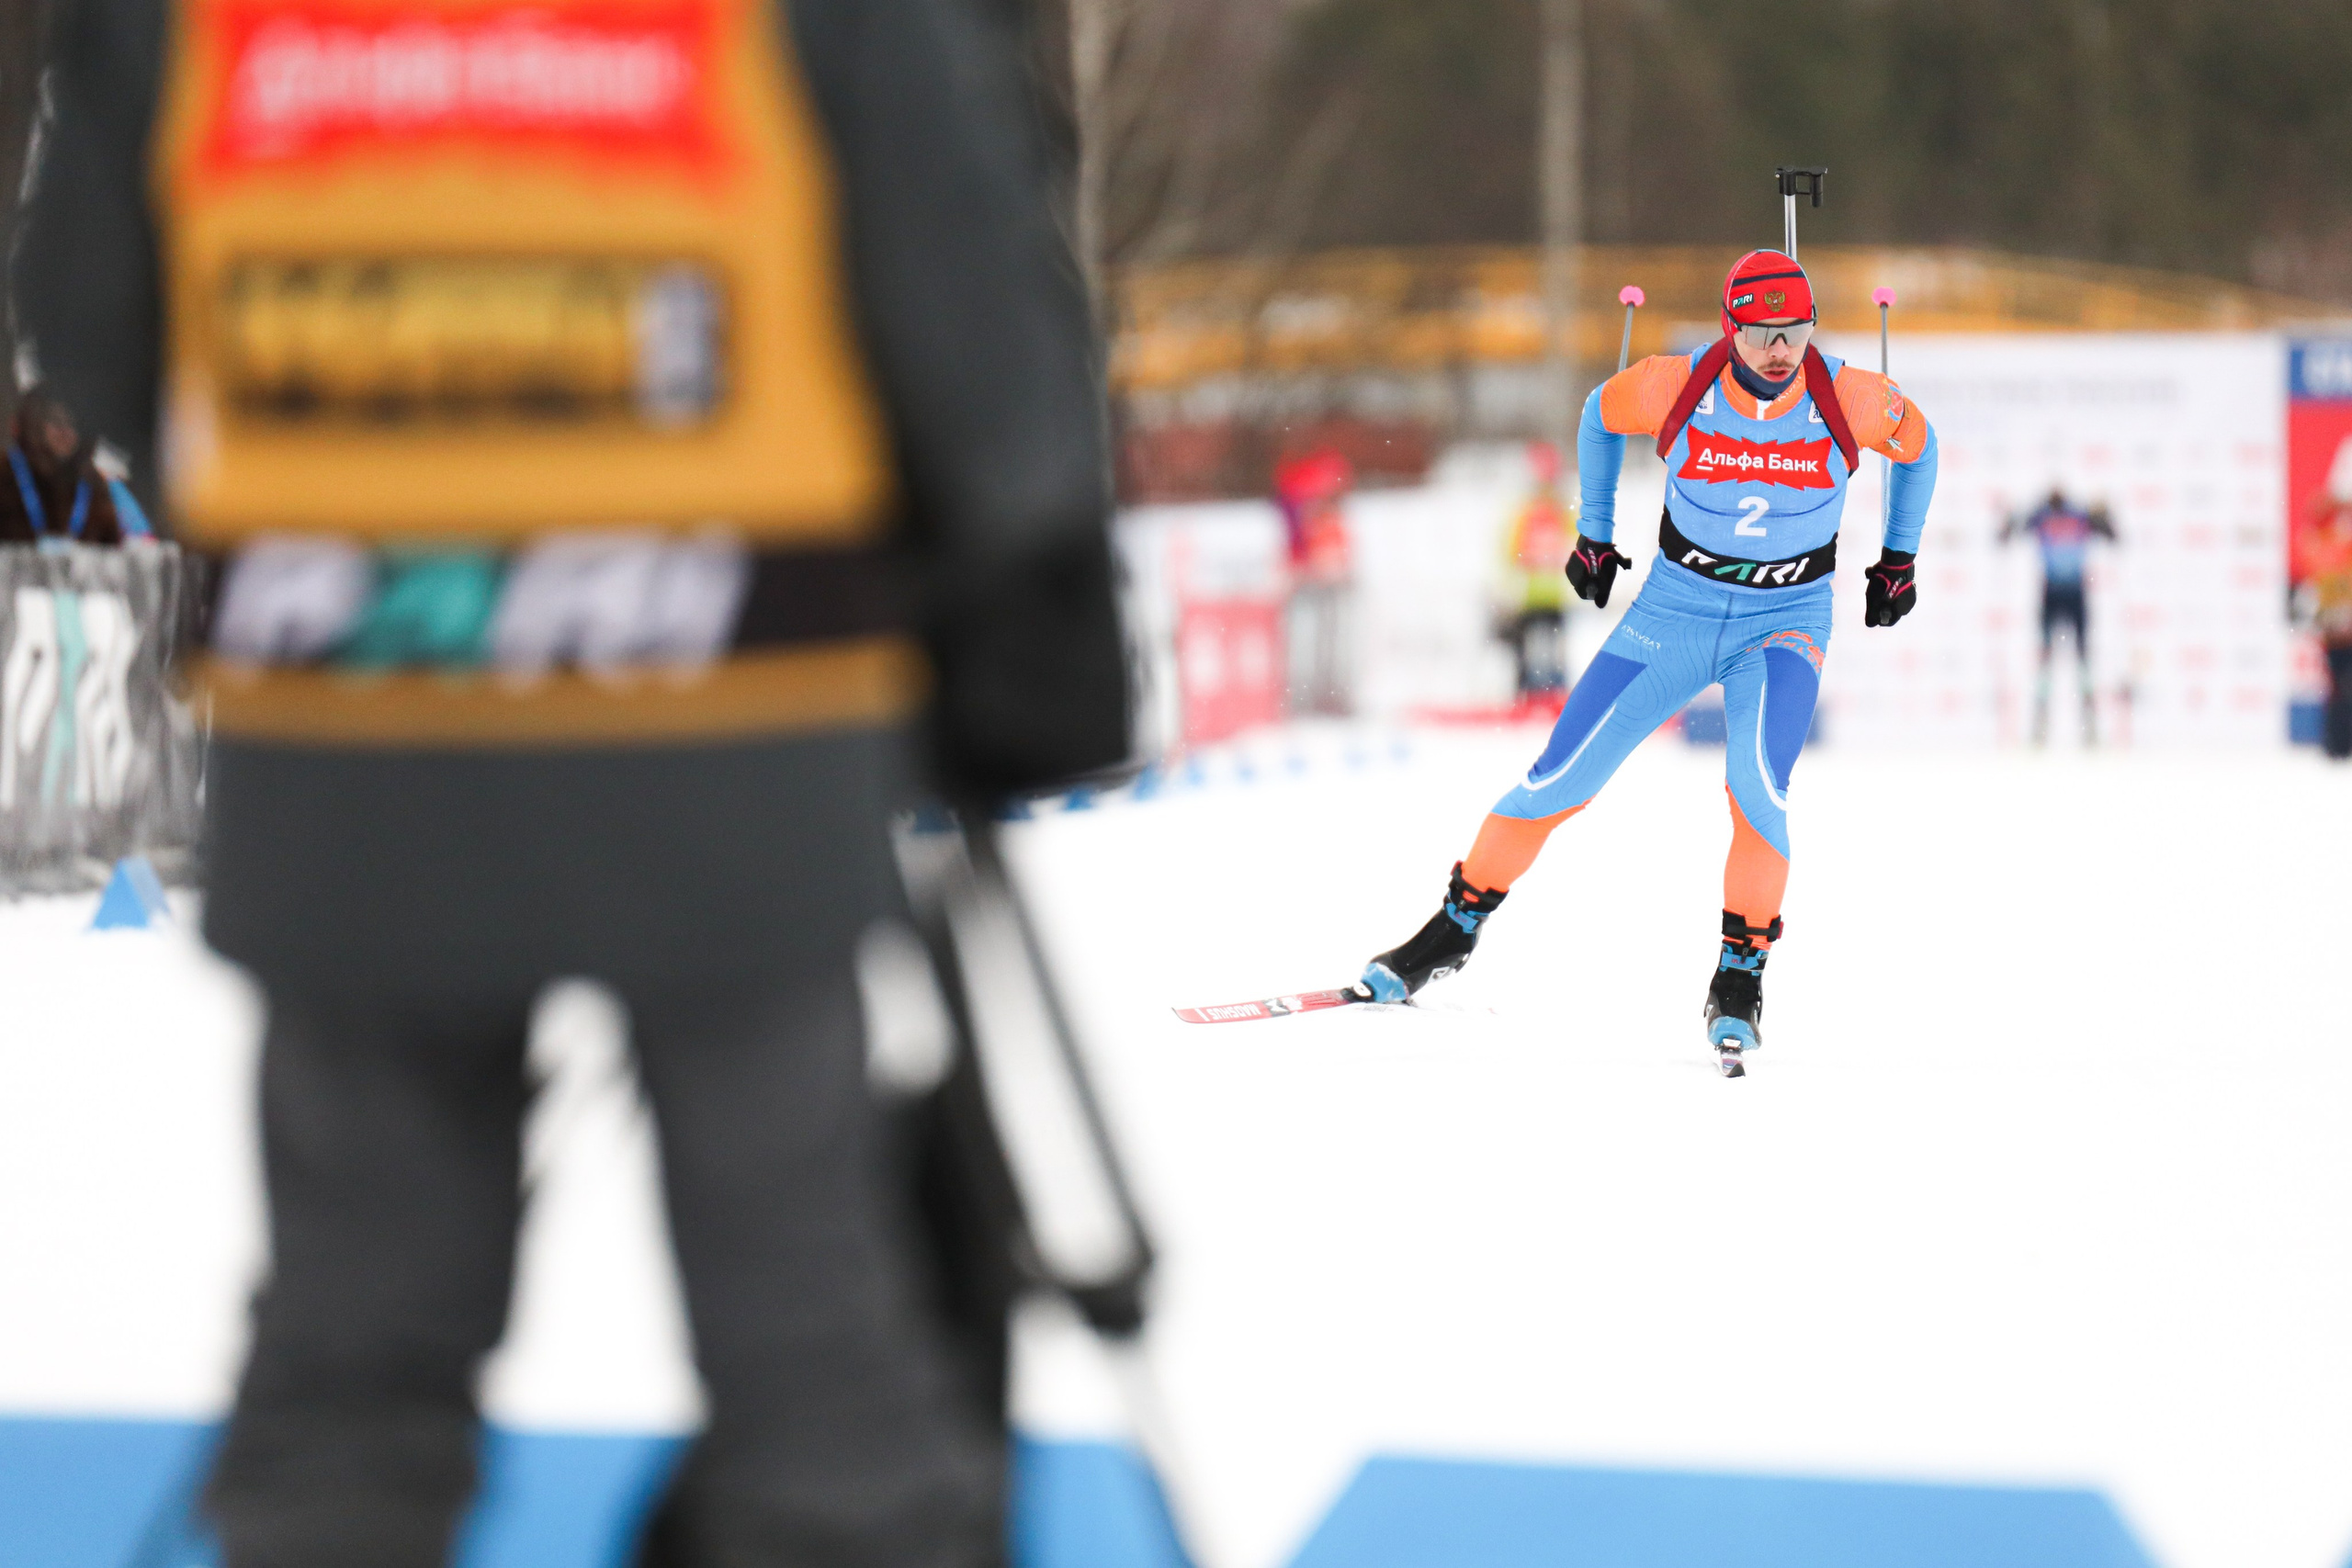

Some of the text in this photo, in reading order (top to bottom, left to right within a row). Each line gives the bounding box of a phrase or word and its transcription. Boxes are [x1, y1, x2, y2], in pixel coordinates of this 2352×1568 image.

[1733, 293, 1754, 308] PARI
[1697, 447, 1819, 472] Альфа Банк
[1734, 495, 1770, 537] 2
[1205, 1003, 1262, 1021] MADSHUS
